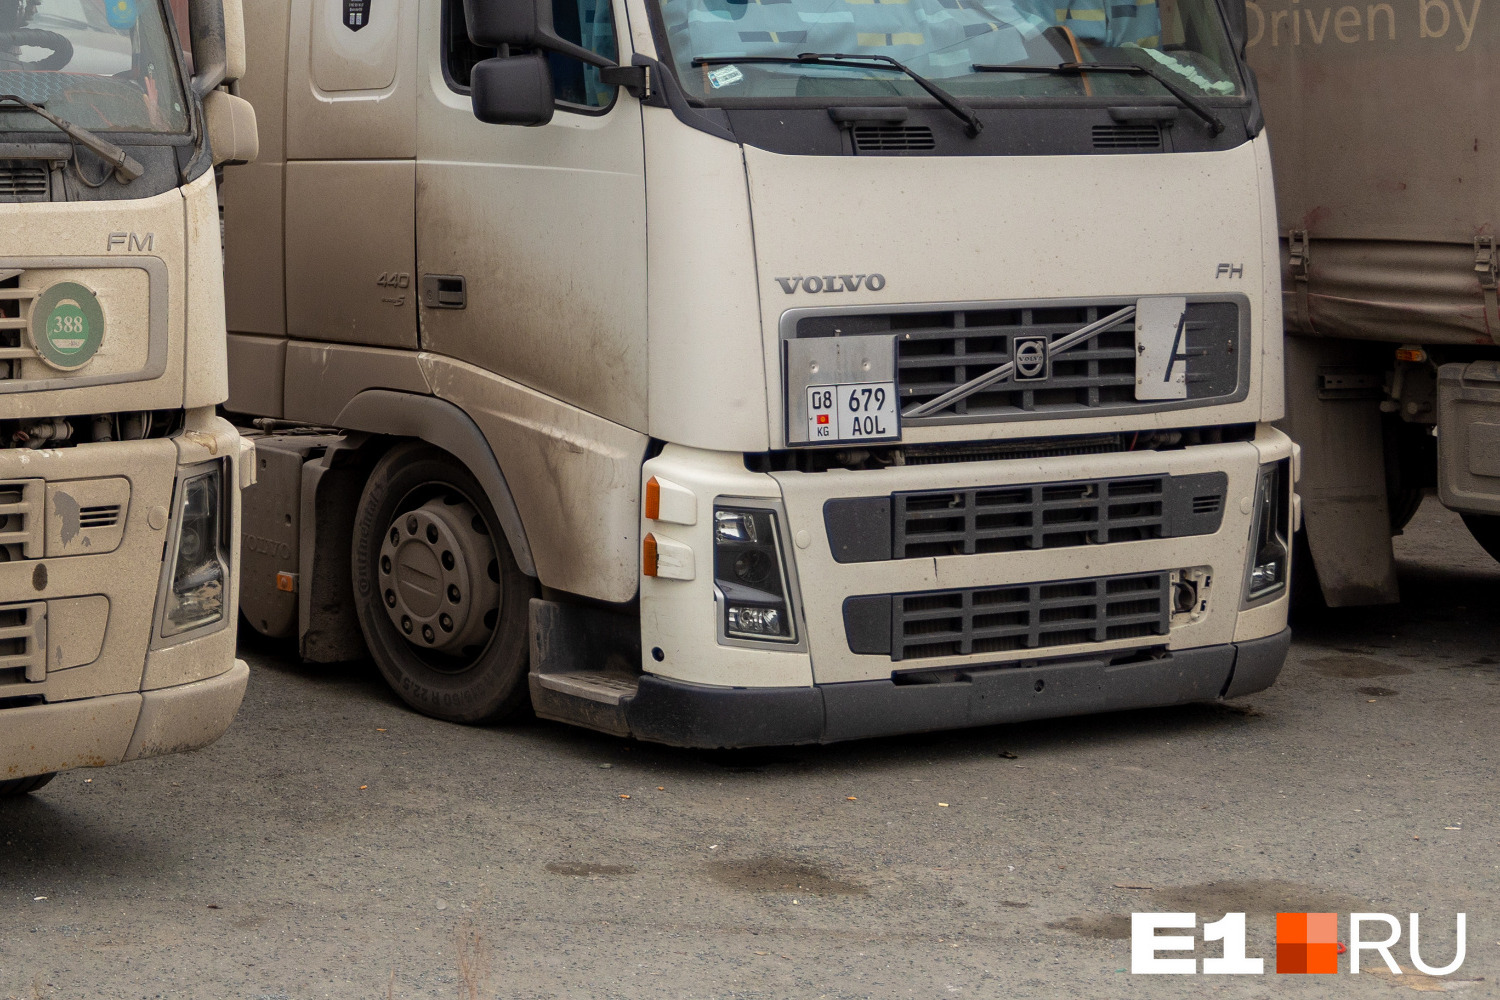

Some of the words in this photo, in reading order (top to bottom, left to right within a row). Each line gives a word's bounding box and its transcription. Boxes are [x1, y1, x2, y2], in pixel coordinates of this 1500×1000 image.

[107, 232, 154, 251] FM
[377, 271, 410, 289] 440
[1215, 263, 1244, 279] FH
[774, 273, 886, 295] VOLVO
[53, 315, 83, 333] 388
[811, 390, 832, 410] 08
[848, 387, 886, 412] 679
[817, 426, 830, 437] KG
